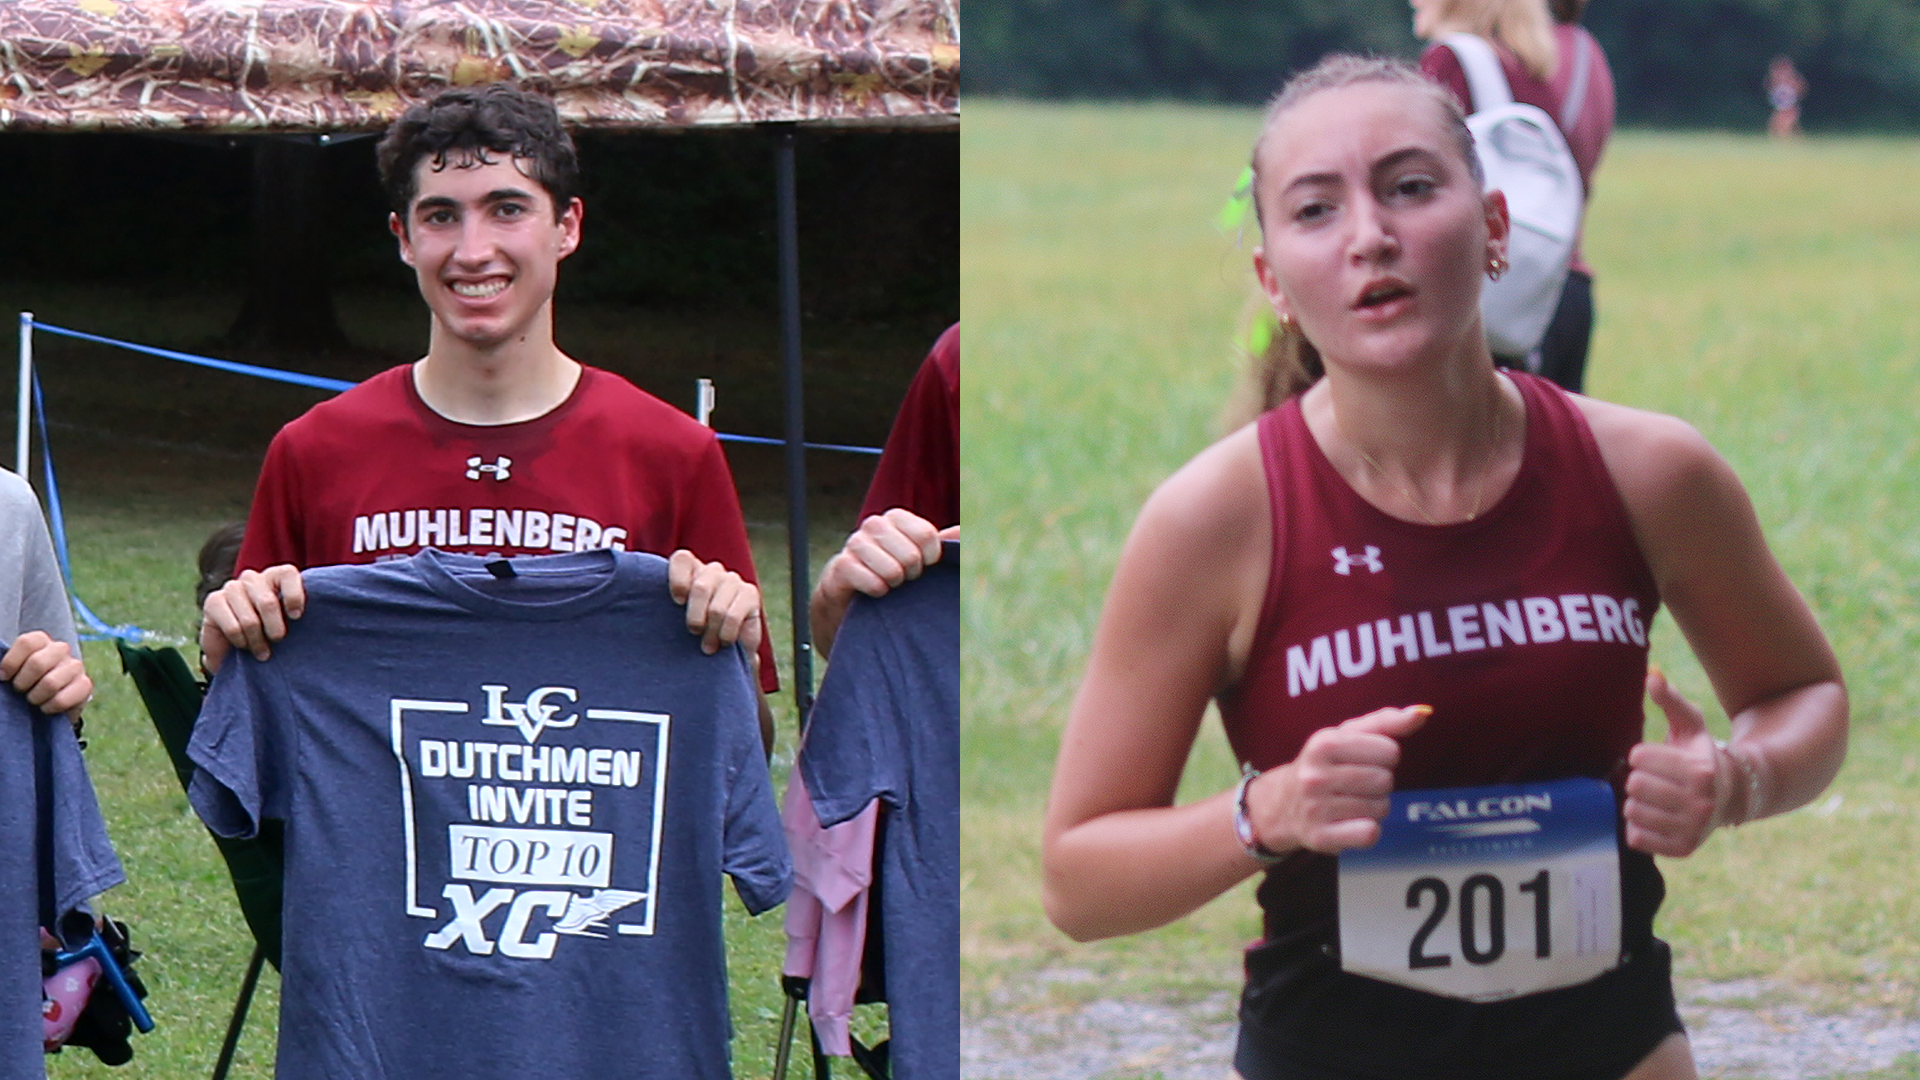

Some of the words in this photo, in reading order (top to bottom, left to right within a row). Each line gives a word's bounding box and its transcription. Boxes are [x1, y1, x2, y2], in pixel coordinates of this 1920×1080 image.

[352, 508, 628, 553] MUHLENBERG
[1285, 593, 1646, 698] MUHLENBERG
[419, 739, 641, 787] DUTCHMEN
[467, 784, 593, 826] INVITE
[1406, 792, 1552, 822] FALCON
[460, 835, 551, 876] TOP
[559, 843, 601, 878] 10
[423, 883, 574, 960] XC
[1405, 869, 1551, 971] 201
